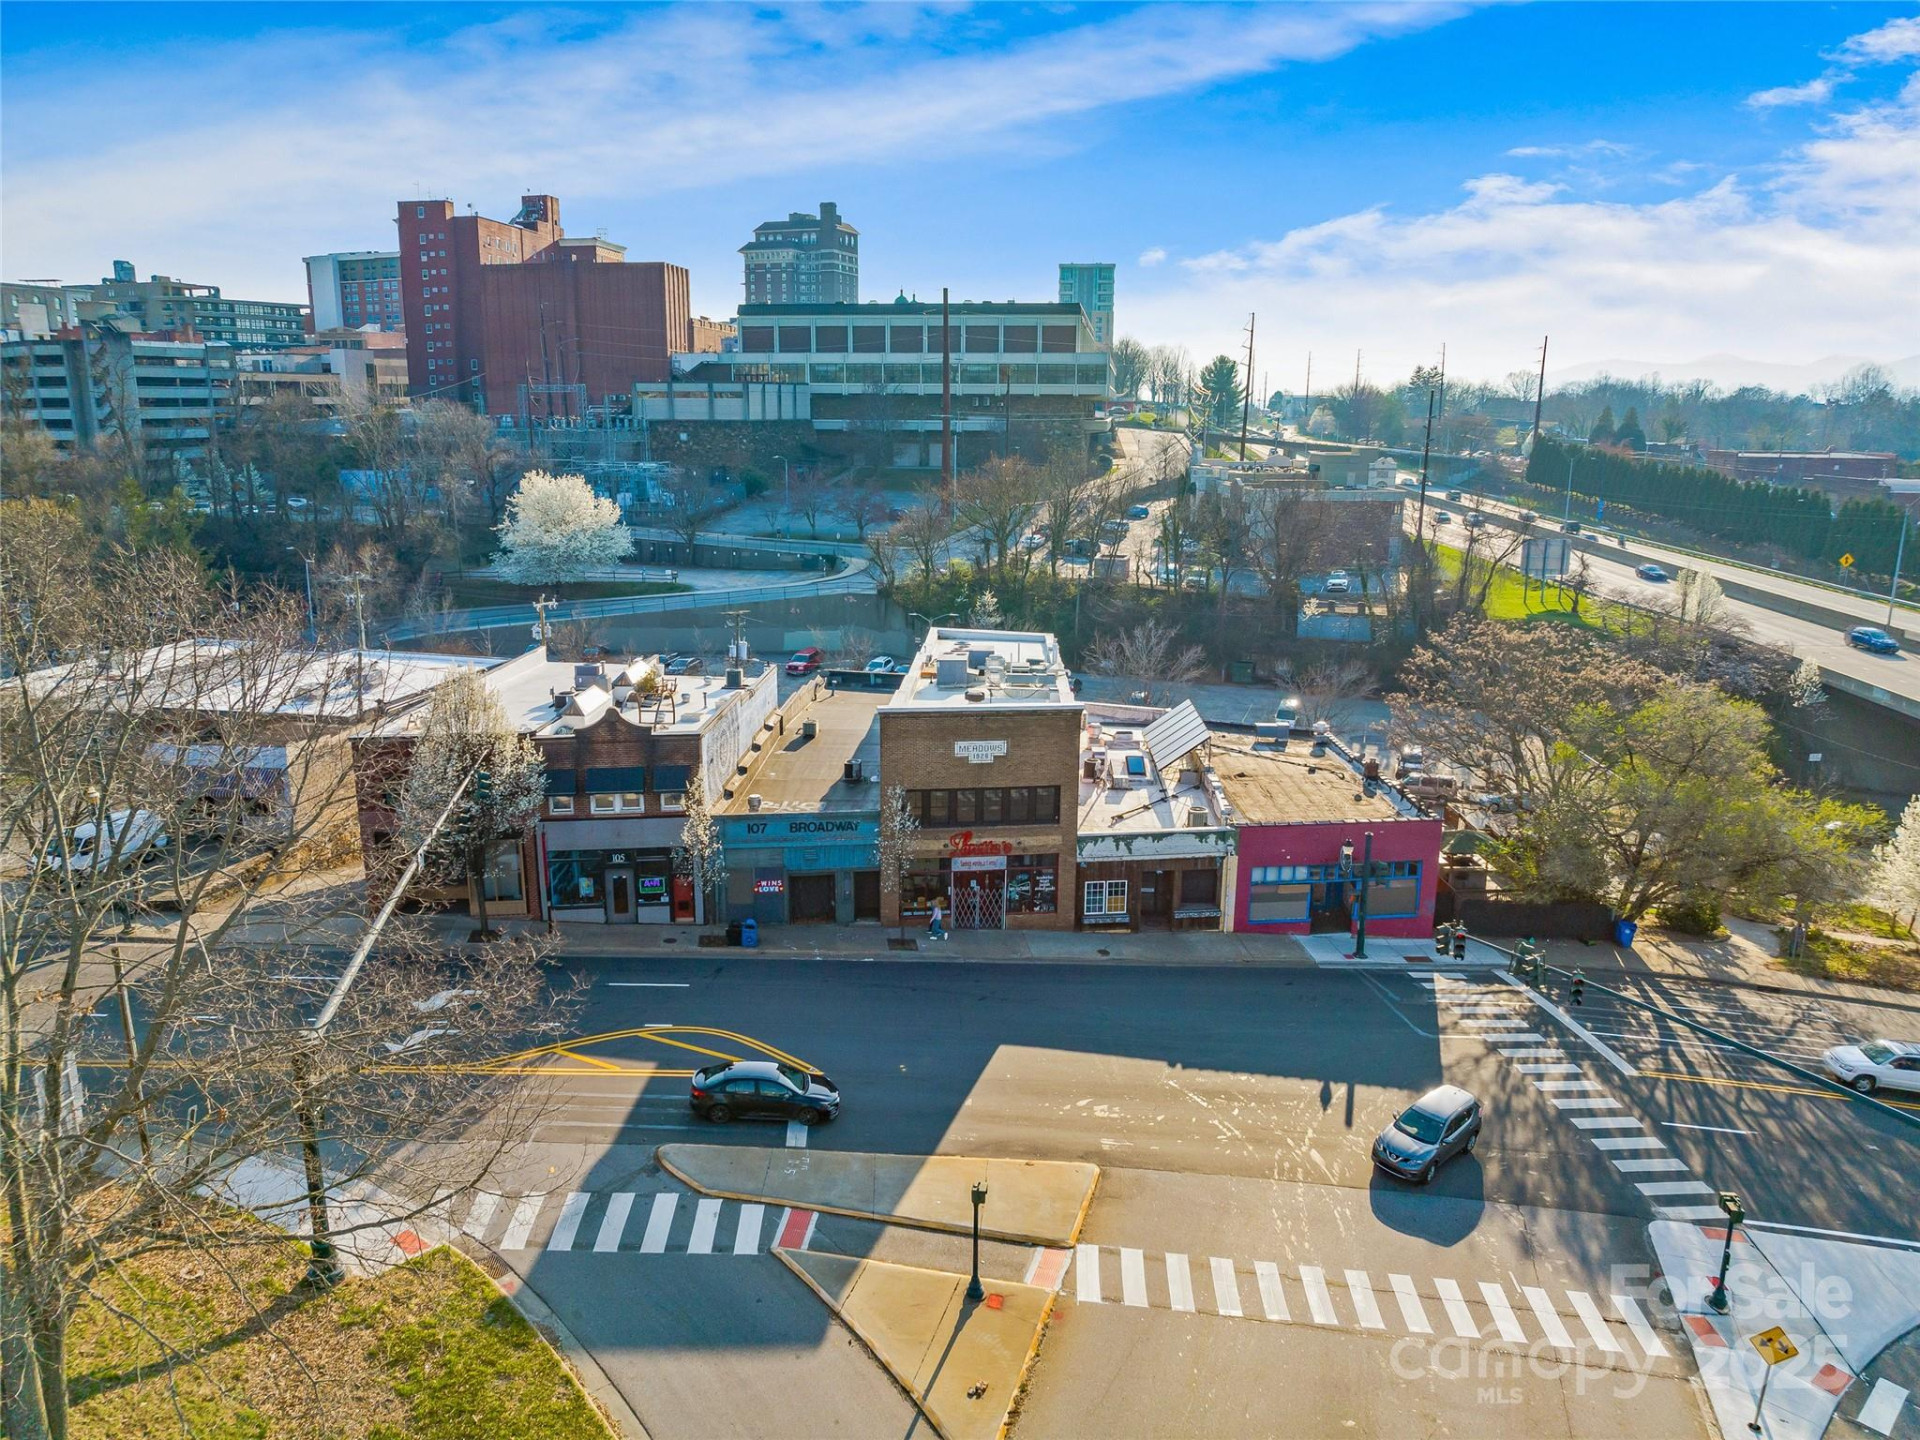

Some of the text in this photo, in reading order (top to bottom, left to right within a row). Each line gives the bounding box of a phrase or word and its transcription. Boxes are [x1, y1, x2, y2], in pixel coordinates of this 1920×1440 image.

[958, 744, 1003, 752] MEADOWS
[747, 820, 860, 834] 107 BROADWAY
[611, 853, 626, 862] 105
